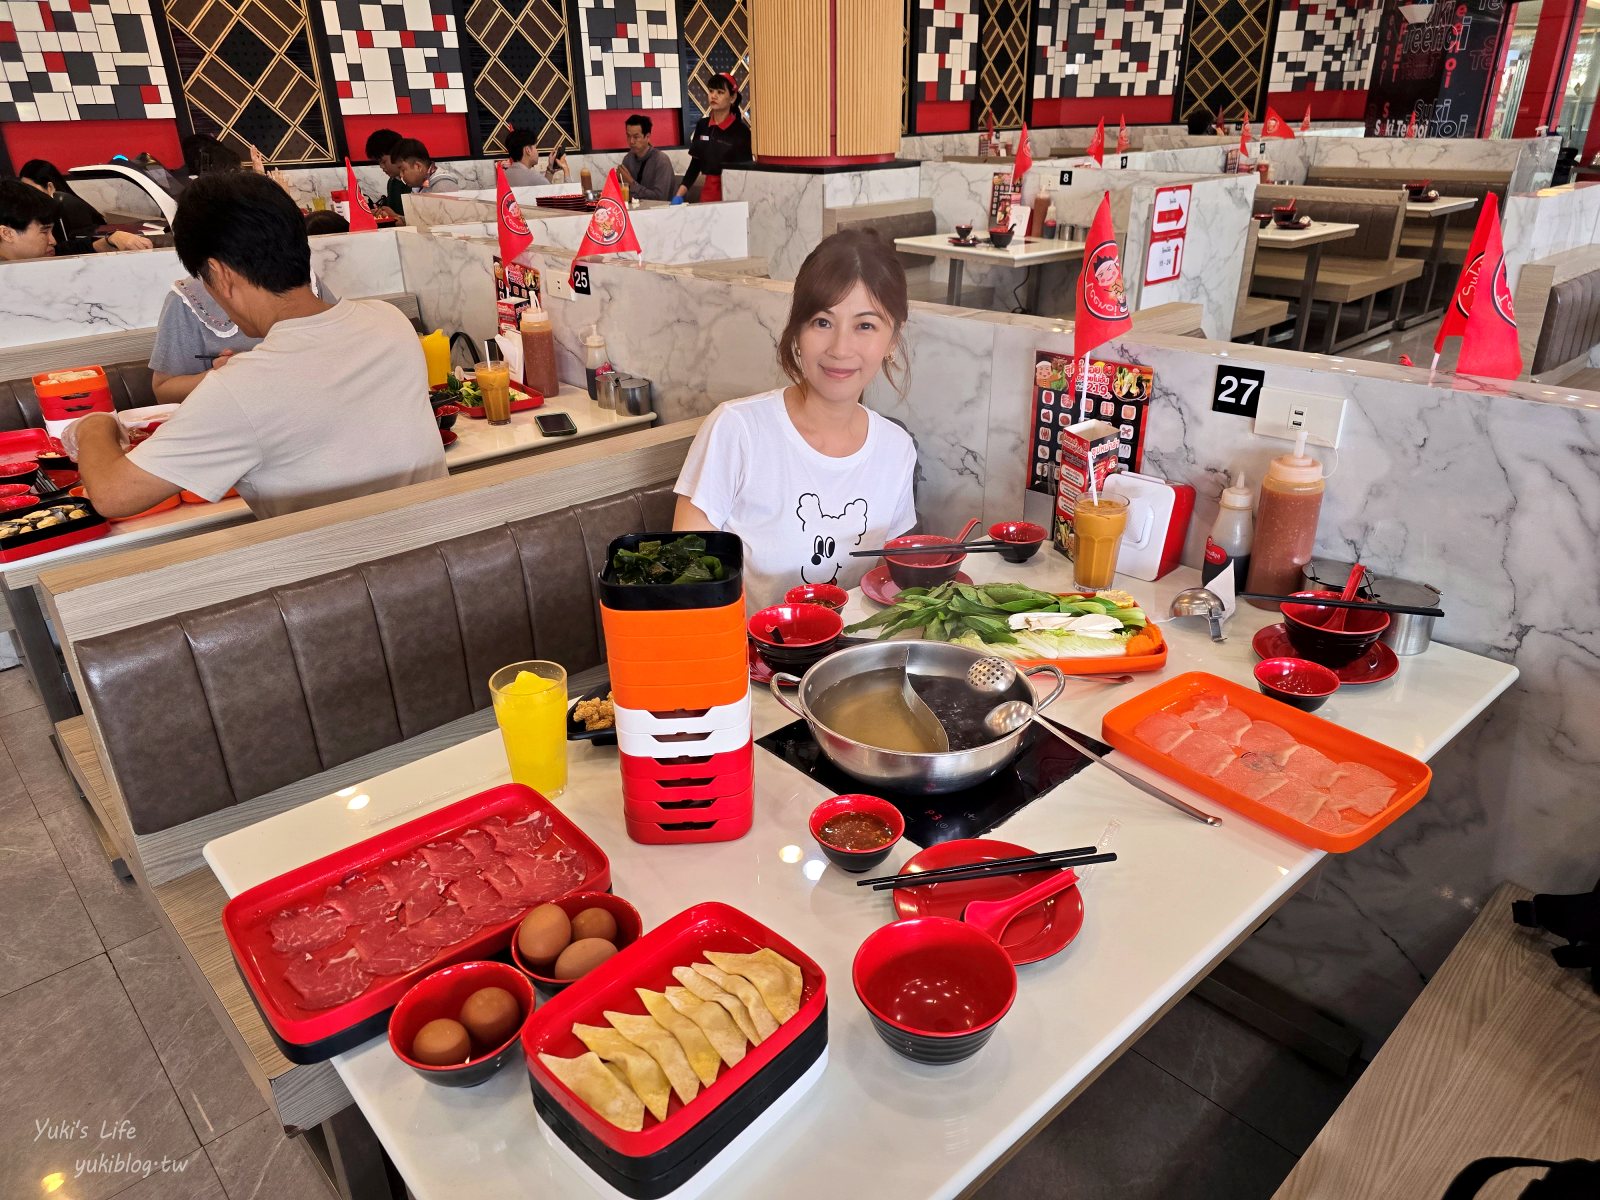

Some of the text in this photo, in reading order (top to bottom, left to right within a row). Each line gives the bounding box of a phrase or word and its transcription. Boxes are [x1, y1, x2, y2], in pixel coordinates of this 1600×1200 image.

[1063, 173, 1069, 182] 8
[574, 271, 588, 288] 25
[1217, 375, 1259, 406] 27
